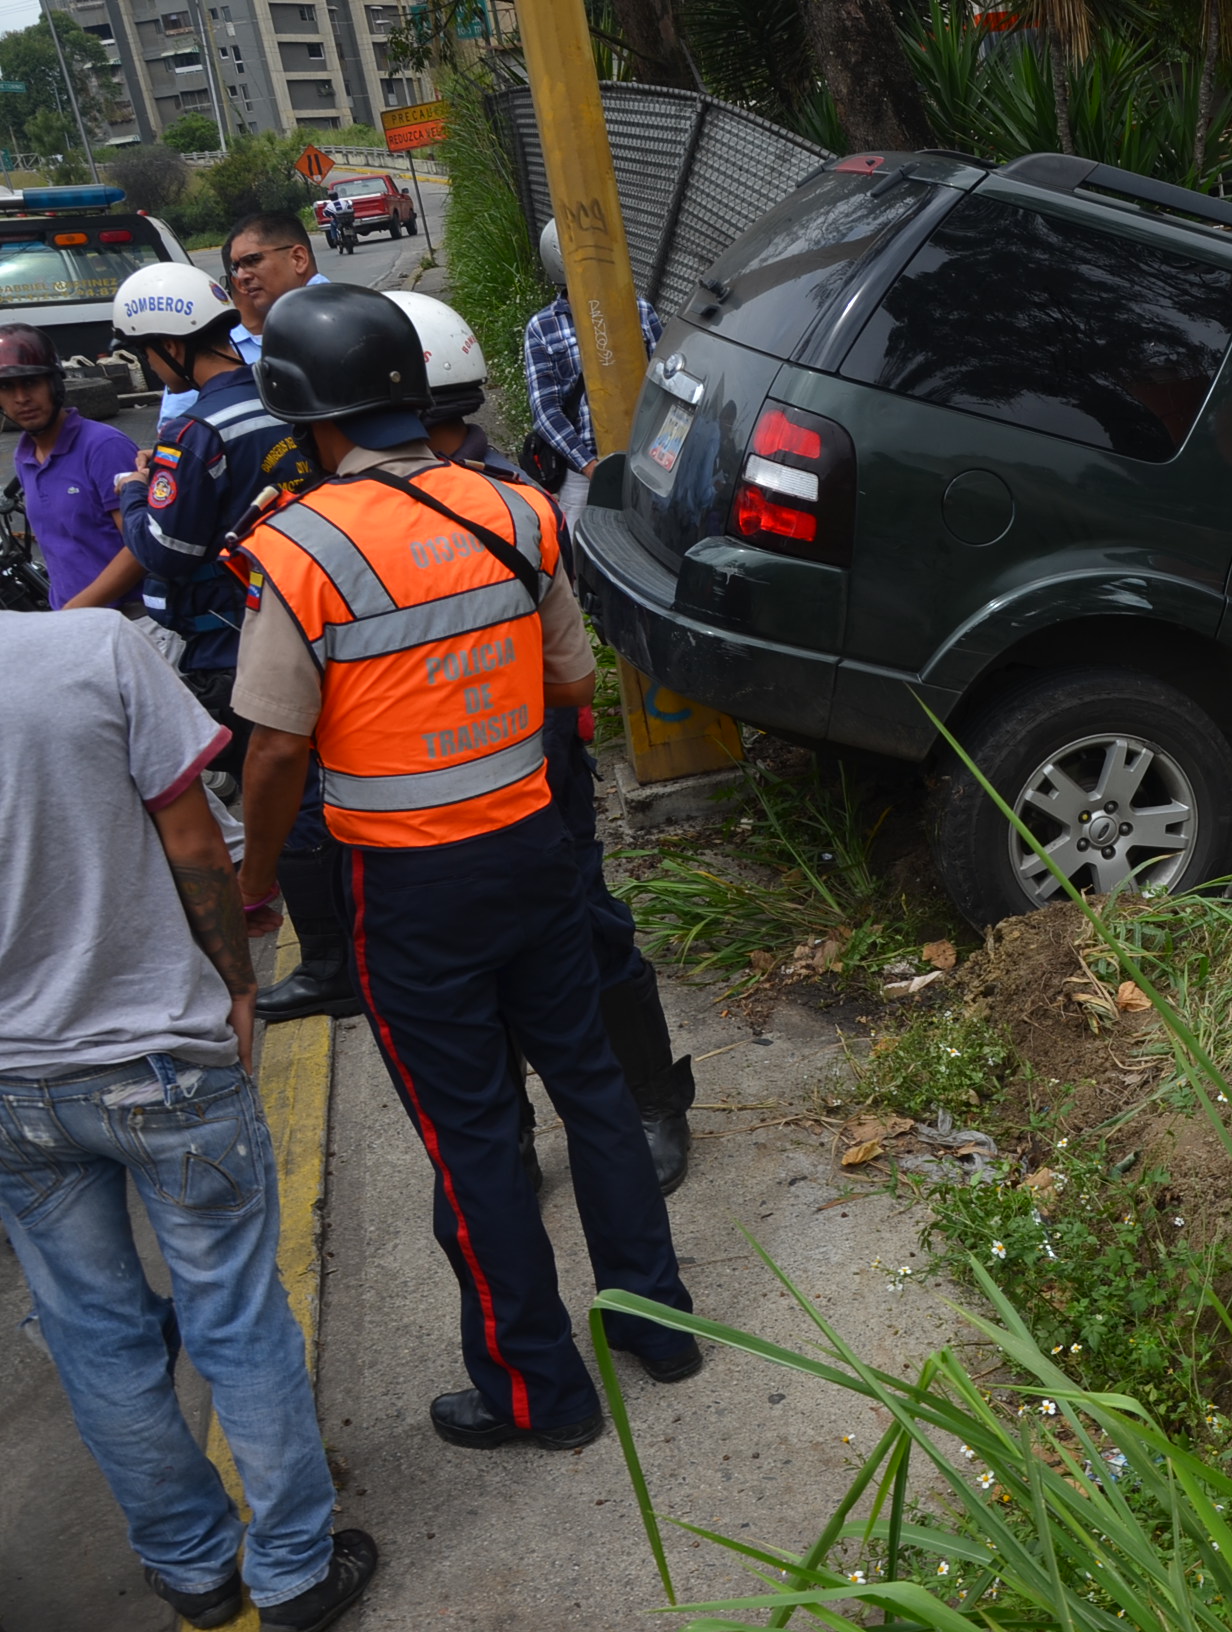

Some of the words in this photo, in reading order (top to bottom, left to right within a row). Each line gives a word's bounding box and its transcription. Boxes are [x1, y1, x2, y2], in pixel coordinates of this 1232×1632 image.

[388, 129, 425, 146] REDUZCA
[124, 296, 194, 317] BOMBEROS
[425, 637, 517, 685] POLICIA
[463, 682, 494, 715] DE
[421, 704, 529, 759] TRANSITO
